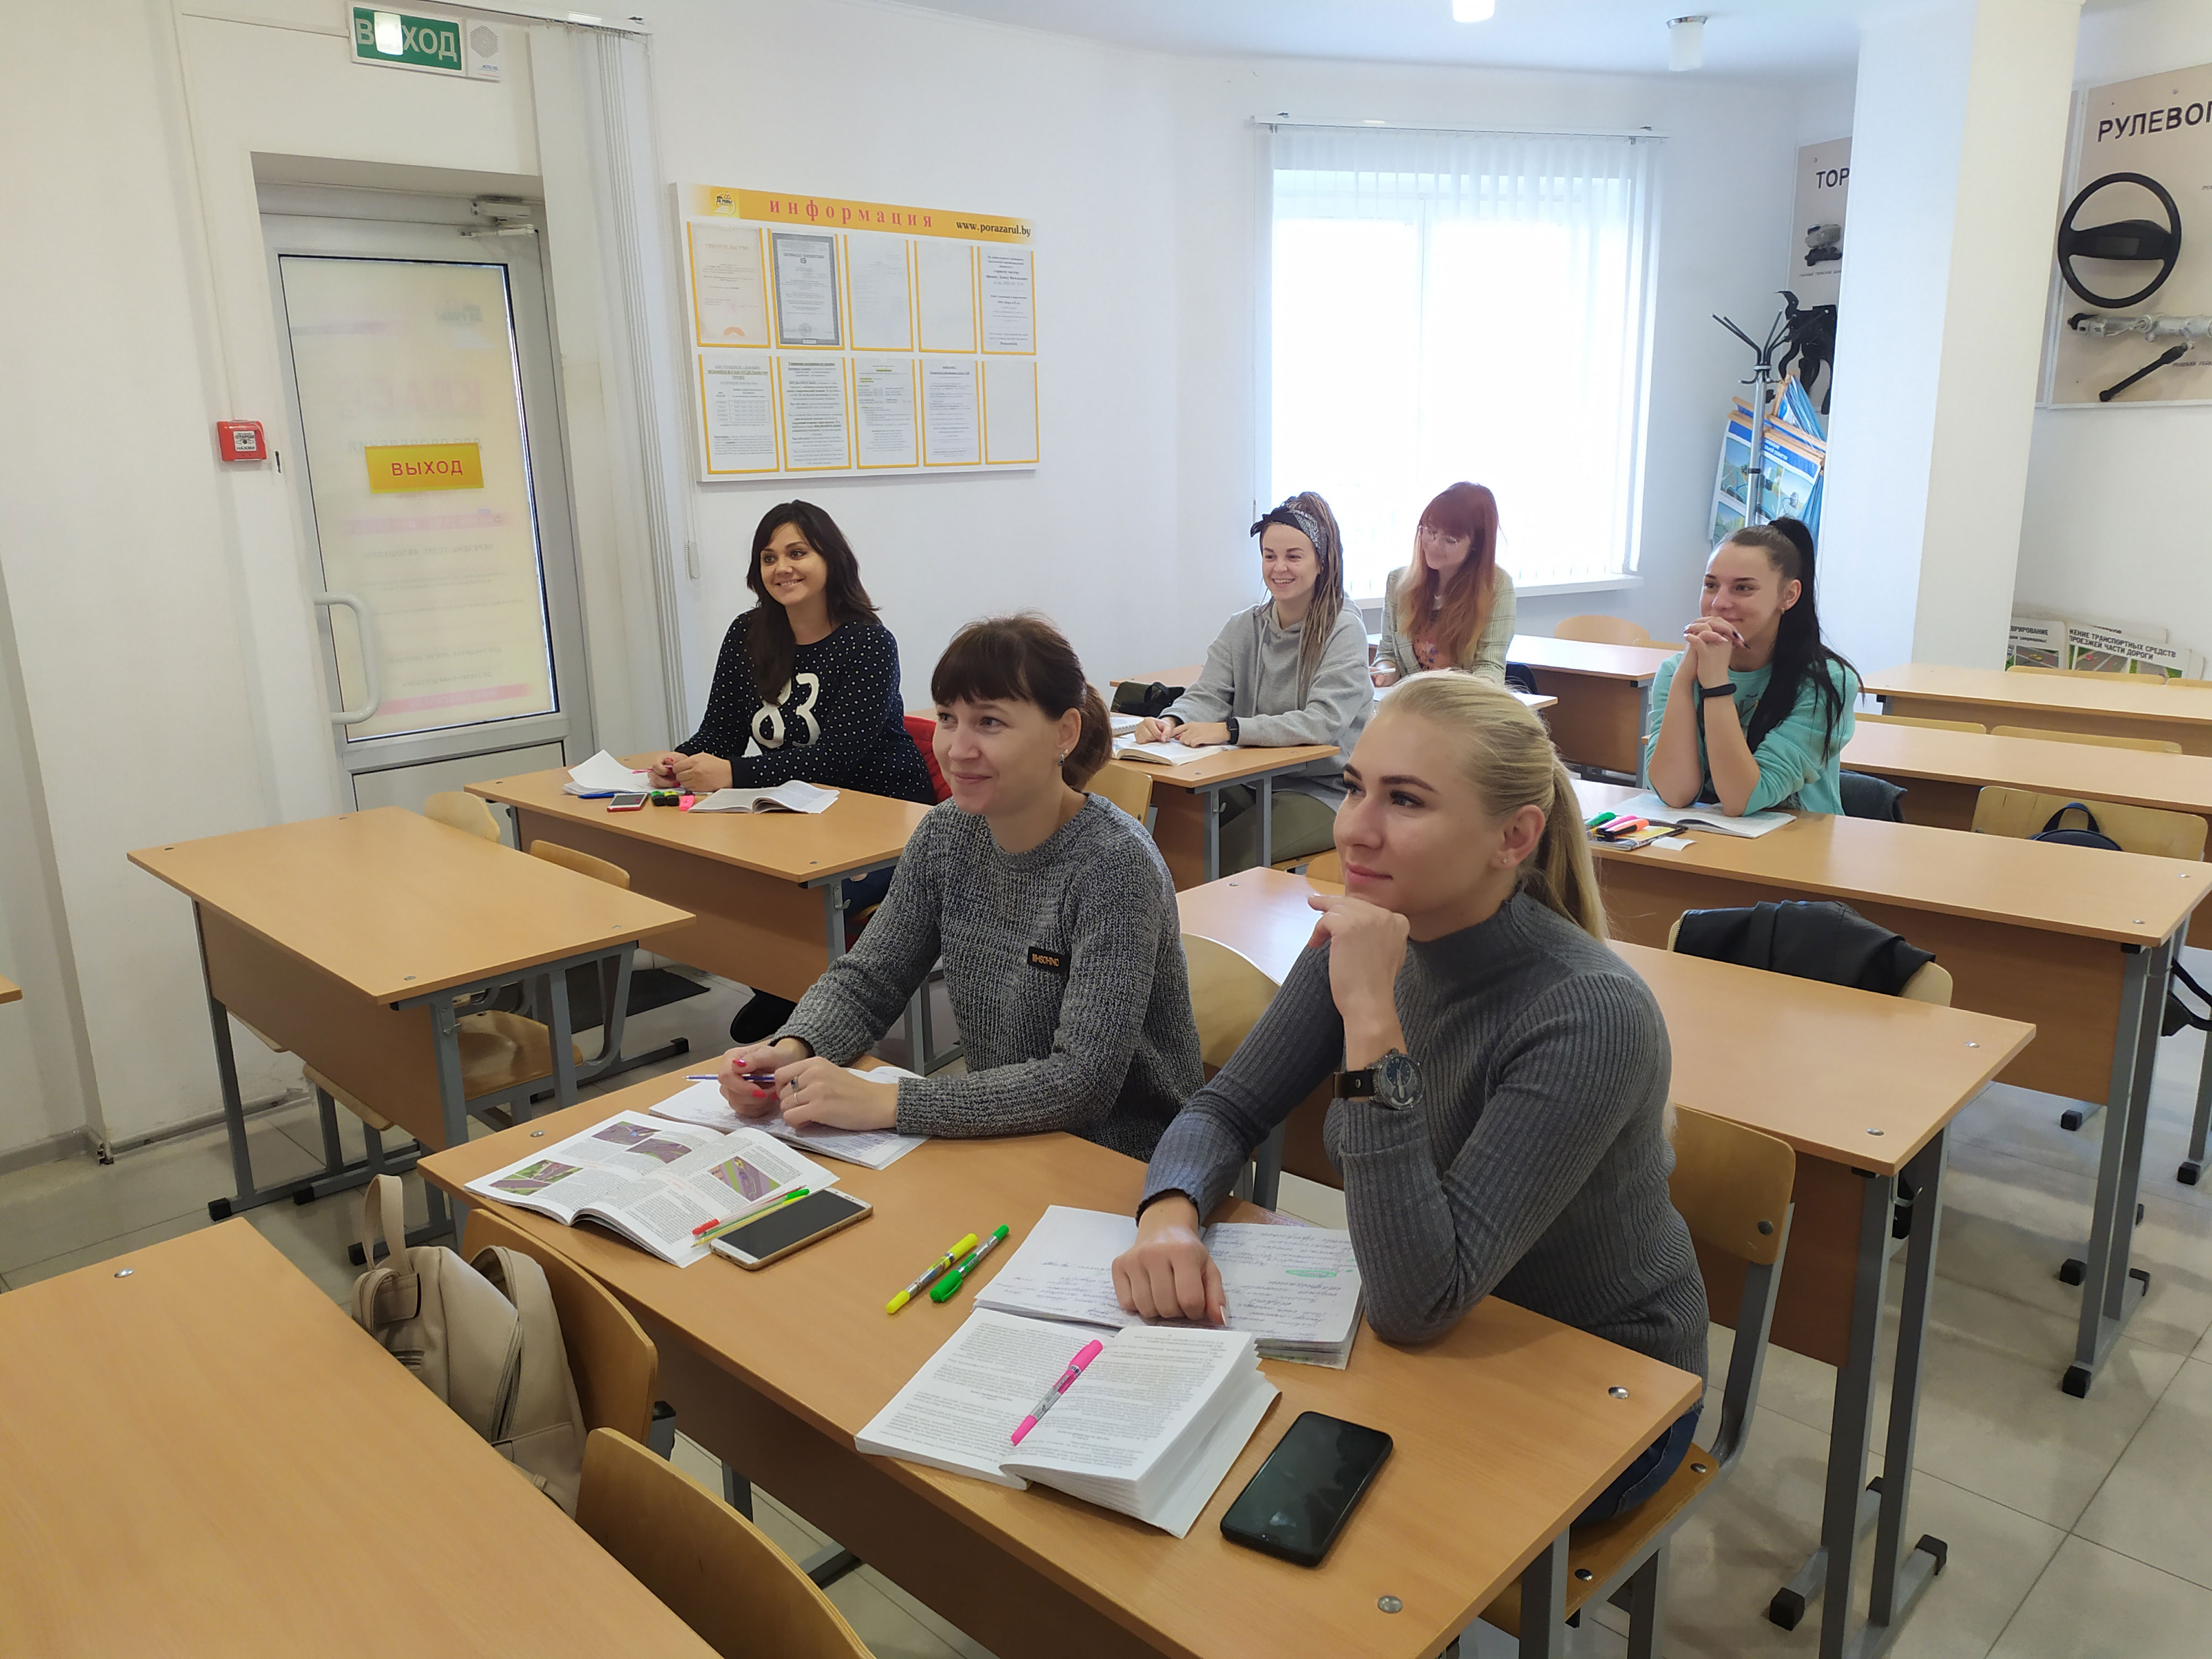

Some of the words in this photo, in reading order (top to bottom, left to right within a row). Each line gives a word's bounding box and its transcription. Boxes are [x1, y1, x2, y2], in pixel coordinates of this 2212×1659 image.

[355, 18, 458, 62] ВХОД
[1816, 167, 1850, 189] ТОР
[770, 199, 932, 227] информация
[956, 221, 1031, 237] www.porazarul.by
[392, 459, 463, 477] ВЫХОД
[2010, 625, 2048, 636] ВРИРОВАНИЕ
[2069, 635, 2103, 649] ПРОЕЗЖЕЙ
[2104, 643, 2125, 654] ЧАСТИ
[2126, 649, 2154, 660] ДОРОГИ
[2091, 633, 2144, 651] ТРАНСПОРТНЫХ
[2145, 645, 2177, 658] СРЕДСТВ
